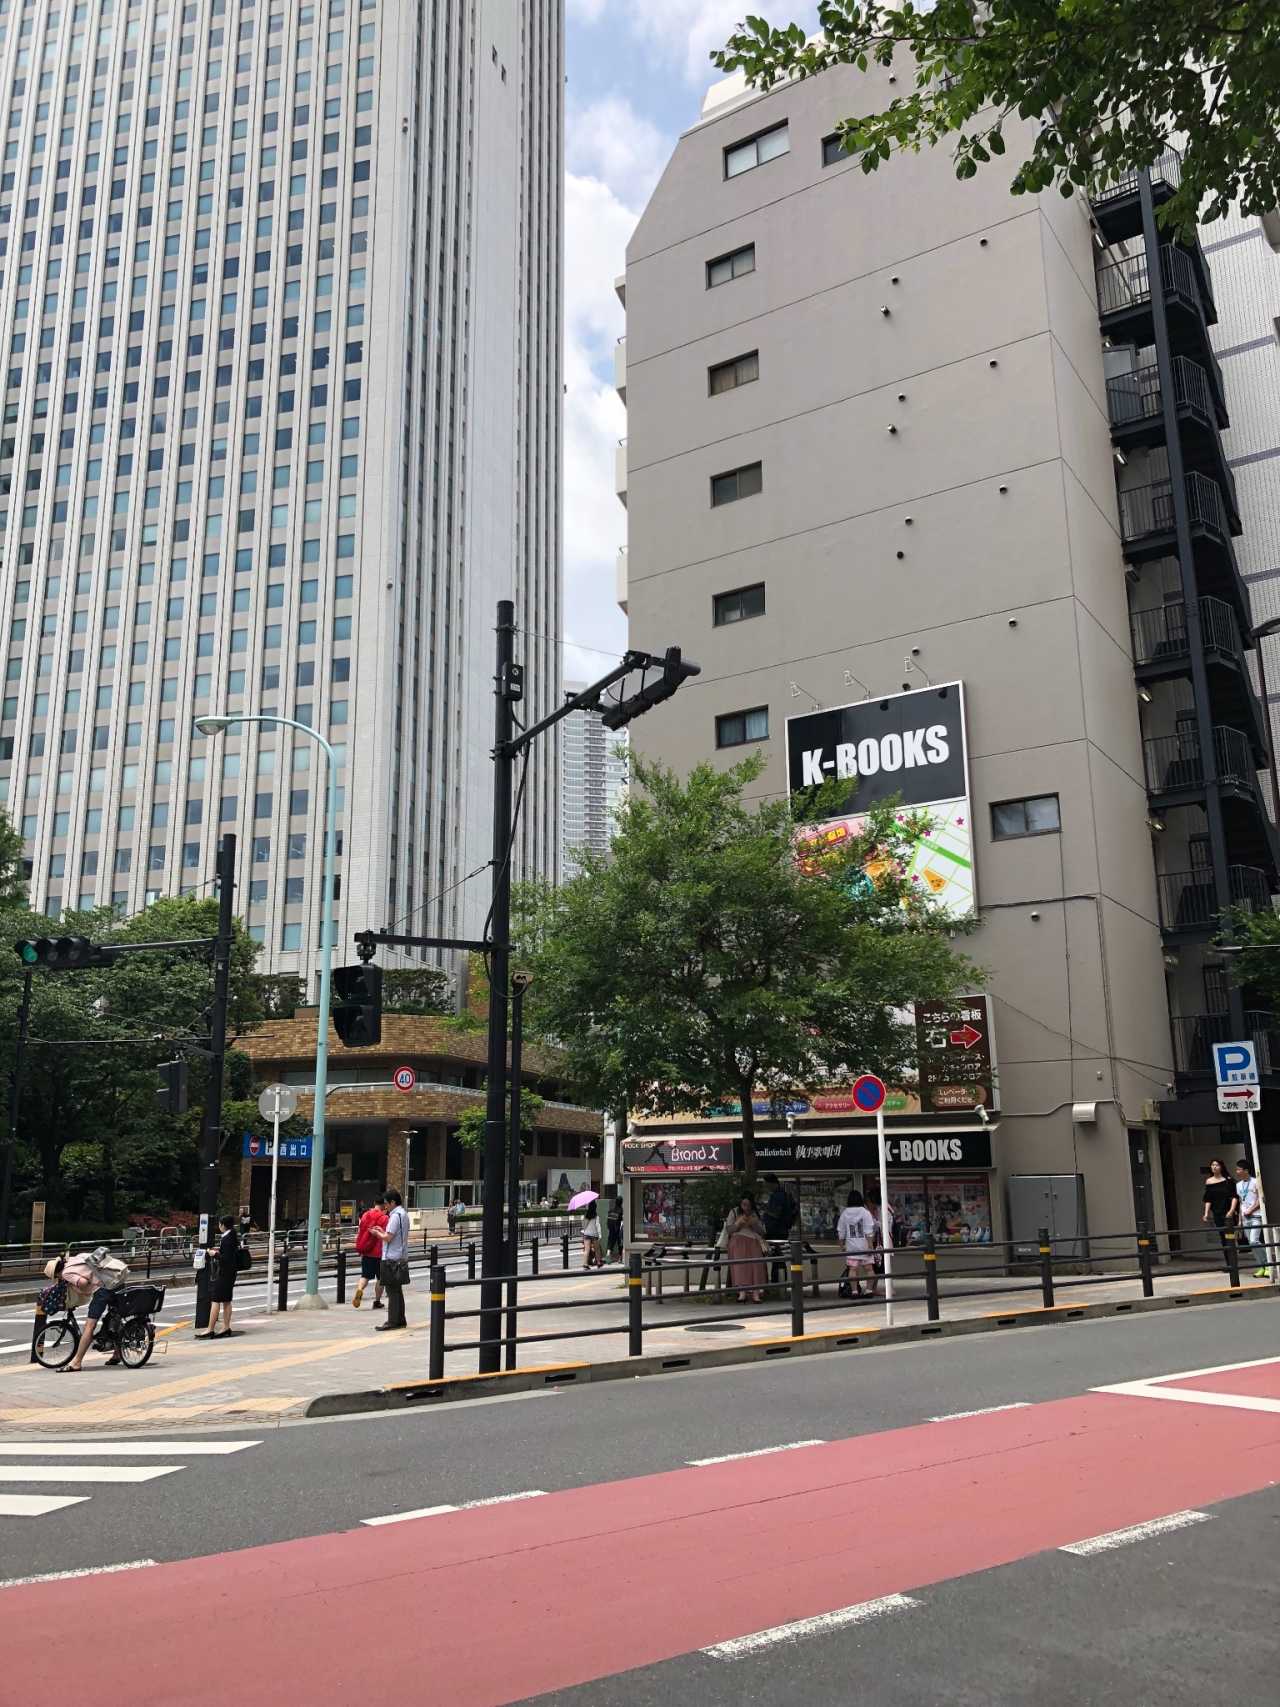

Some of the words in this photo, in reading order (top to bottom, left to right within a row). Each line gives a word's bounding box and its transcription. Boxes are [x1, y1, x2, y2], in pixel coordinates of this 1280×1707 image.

[801, 724, 950, 786] K-BOOKS
[923, 1009, 982, 1023] こちらの看板
[925, 1025, 947, 1048] 右
[1217, 1046, 1251, 1082] P
[399, 1073, 411, 1084] 40
[1221, 1101, 1239, 1110] この先
[671, 1146, 706, 1162] Brand
[708, 1146, 720, 1161] X
[885, 1139, 963, 1162] K-BOOKS
